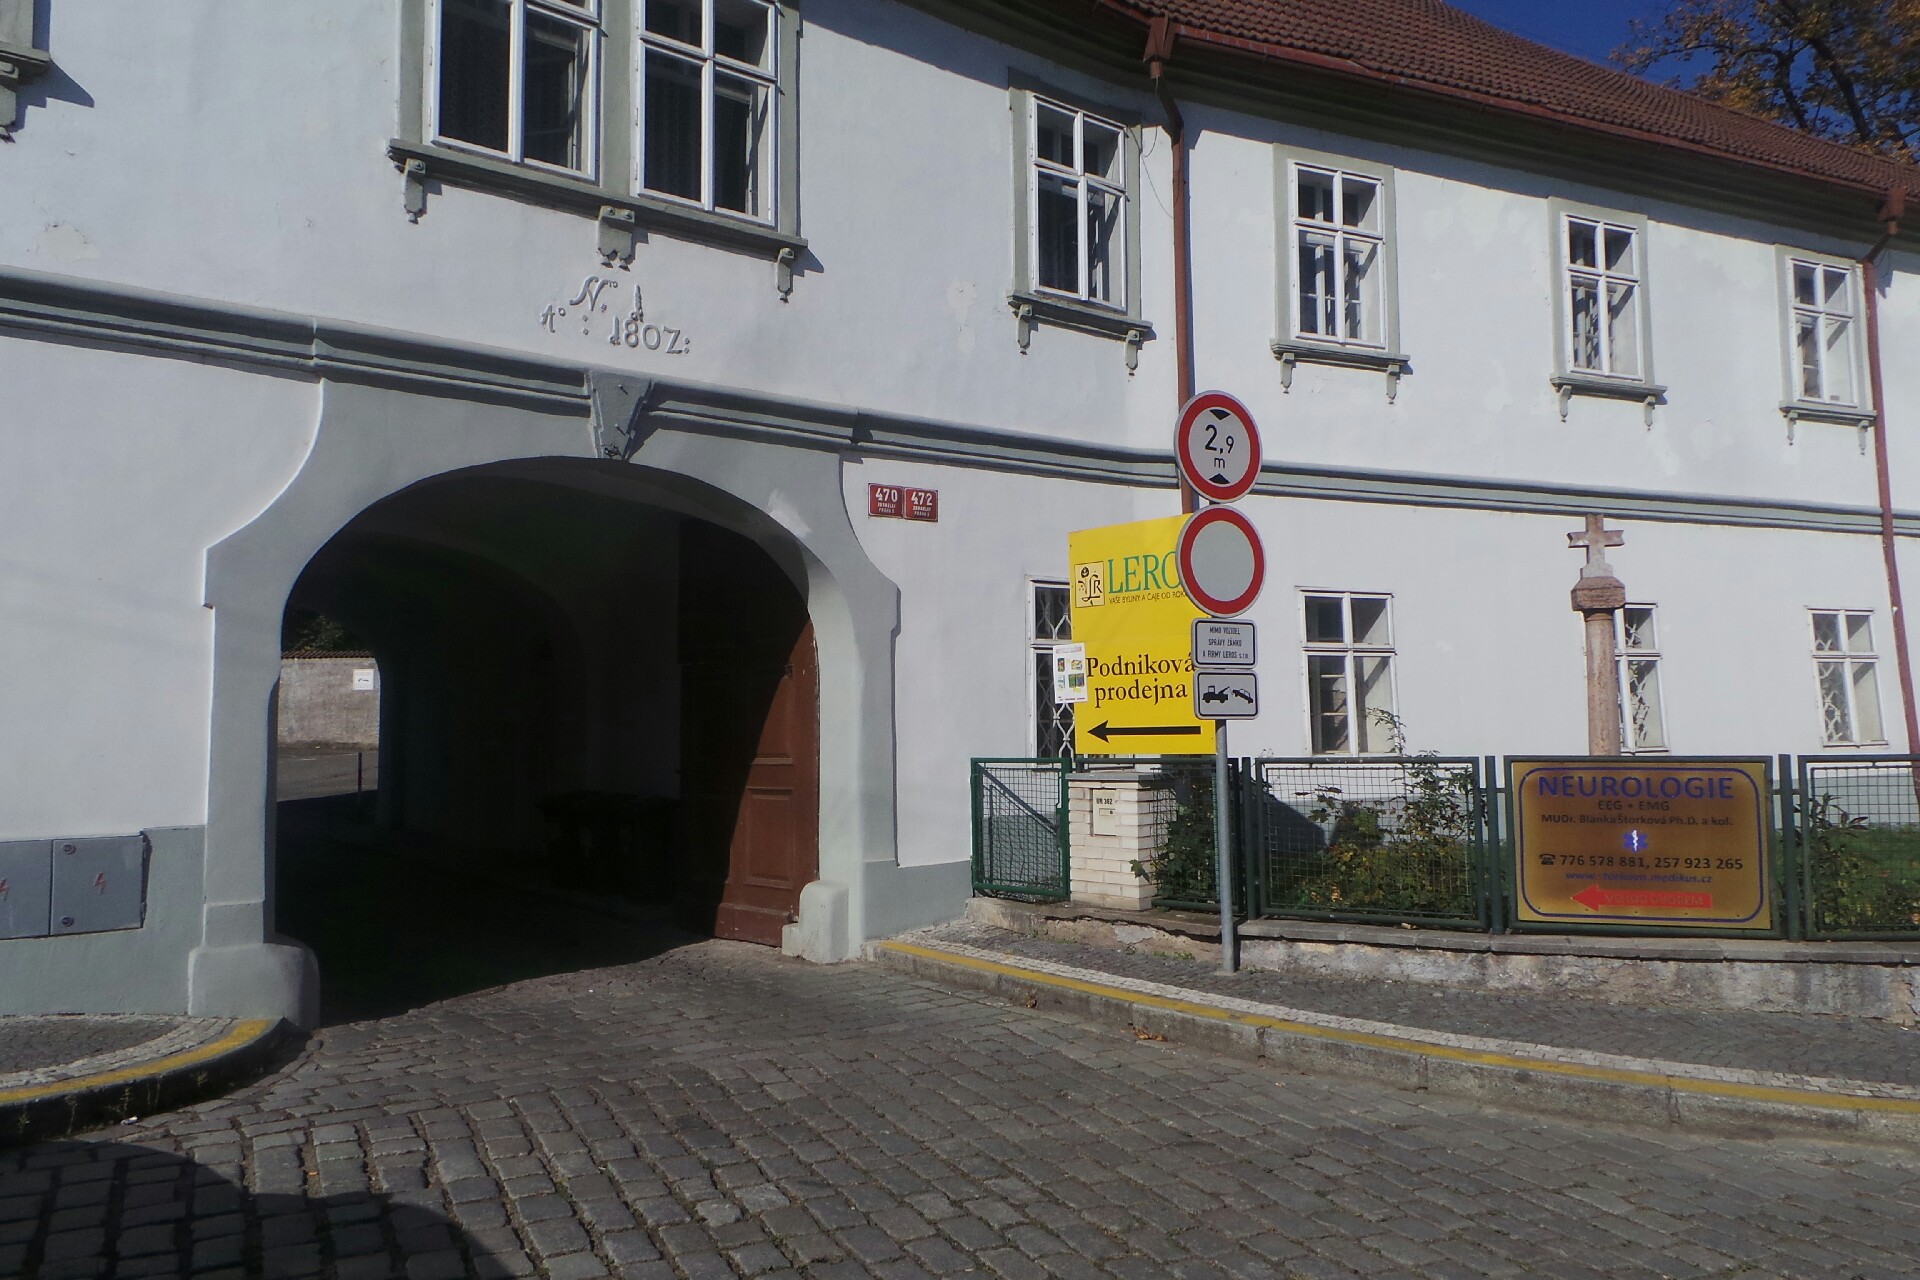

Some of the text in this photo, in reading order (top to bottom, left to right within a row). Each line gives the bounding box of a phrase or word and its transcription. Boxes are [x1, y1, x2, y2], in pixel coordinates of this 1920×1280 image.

[1204, 424, 1235, 455] 2,9
[1213, 457, 1226, 469] m
[876, 488, 898, 502] 470
[911, 492, 932, 506] 472
[1122, 594, 1141, 603] BYLINY
[1147, 592, 1160, 602] ČAJE
[1161, 591, 1171, 600] OD
[1210, 626, 1241, 635] MIMO VOZIDEL
[1208, 637, 1225, 646] SPRÁVY
[1222, 651, 1238, 659] LEROS
[1095, 678, 1188, 709] prodejna
[1538, 776, 1734, 799] NEUROLOGIE
[1598, 801, 1622, 811] EEG
[1639, 801, 1670, 811] EMG
[1541, 814, 1576, 824] MUDr.
[1579, 815, 1617, 825] Blanka
[1669, 817, 1698, 826] Ph.D.
[1711, 817, 1734, 826] kol.
[1560, 855, 1744, 870] 776 578 881, 257 923 265
